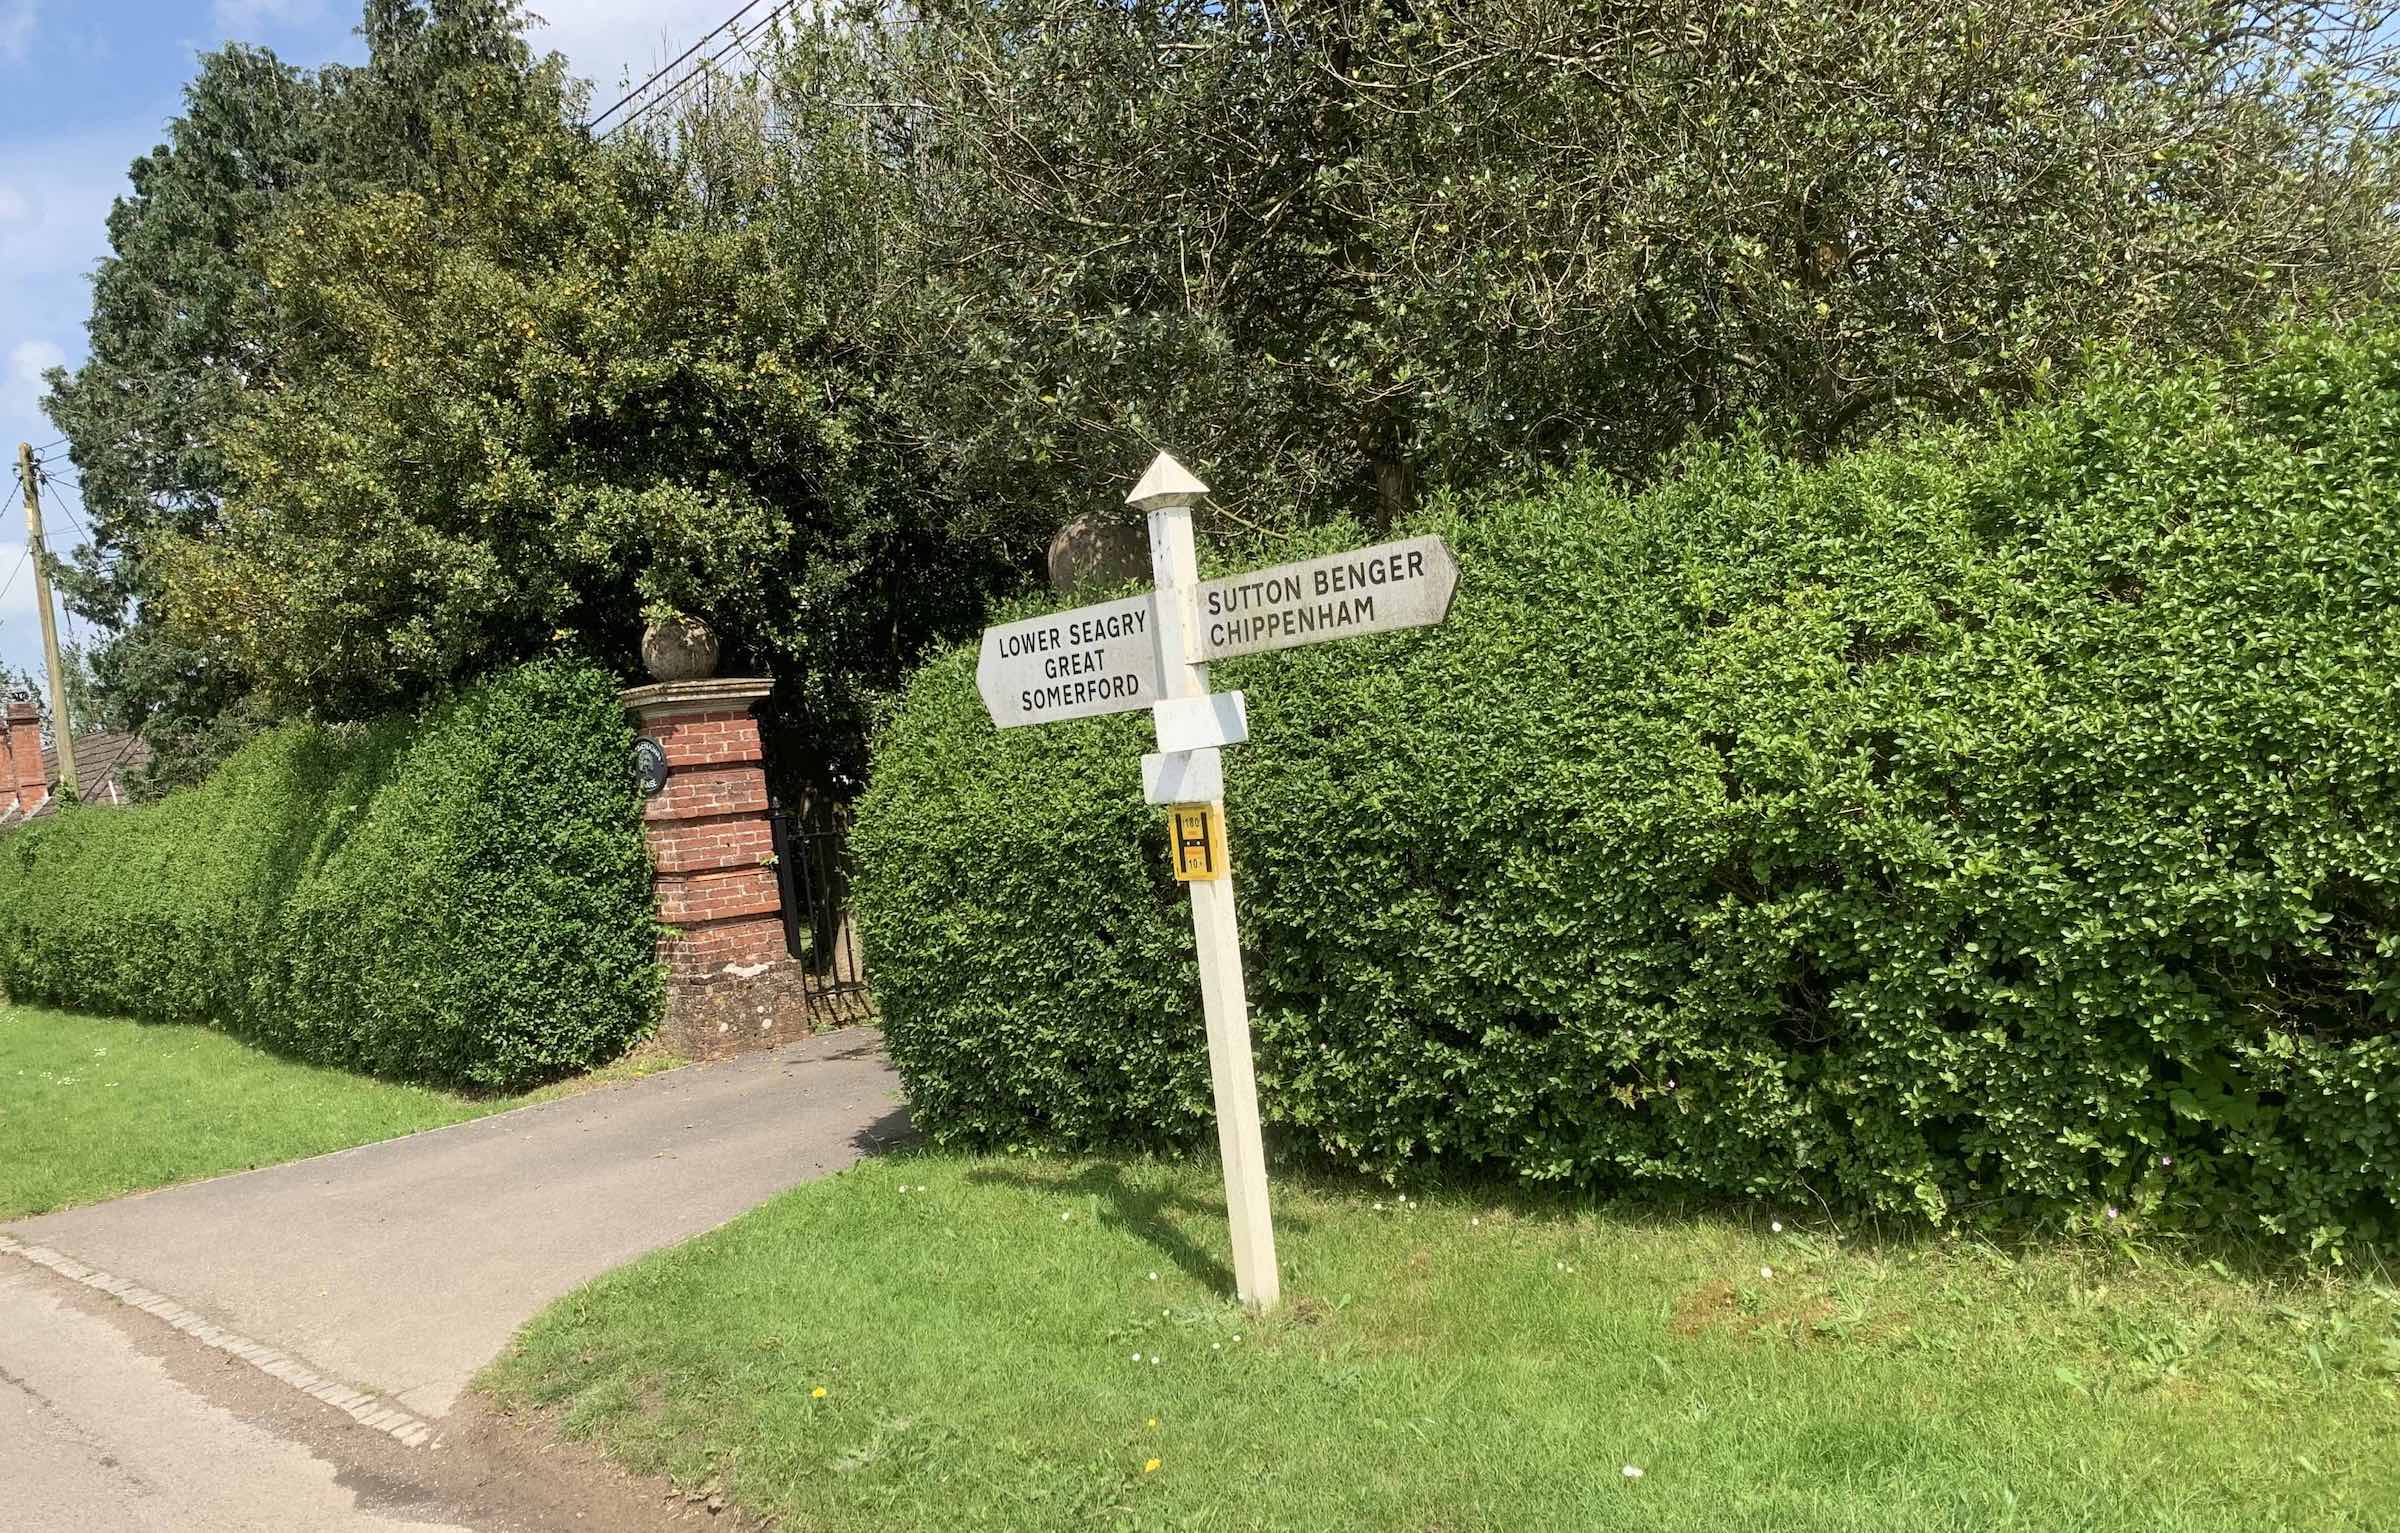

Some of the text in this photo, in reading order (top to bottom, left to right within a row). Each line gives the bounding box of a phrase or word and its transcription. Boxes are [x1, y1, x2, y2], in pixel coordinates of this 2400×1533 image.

[1208, 550, 1424, 616] SUTTON BENGER
[999, 609, 1146, 659] LOWER SEAGRY
[1210, 596, 1375, 647] CHIPPENHAM
[1045, 649, 1105, 679] GREAT
[1022, 674, 1139, 711] SOMERFORD
[1184, 816, 1200, 828] 180
